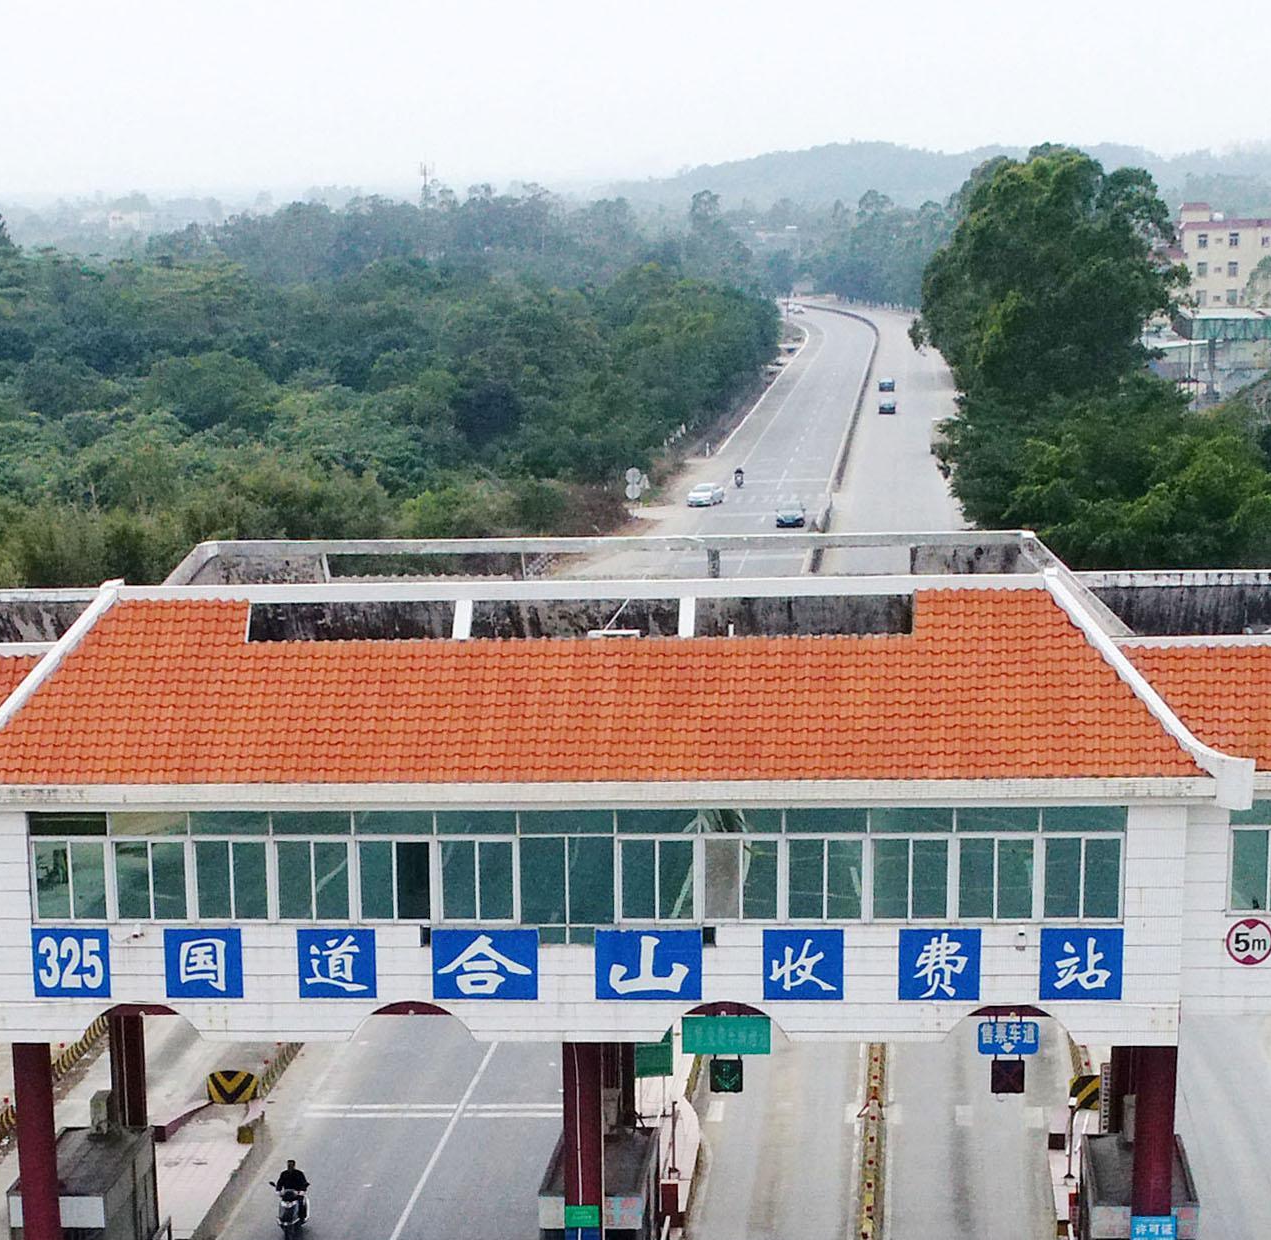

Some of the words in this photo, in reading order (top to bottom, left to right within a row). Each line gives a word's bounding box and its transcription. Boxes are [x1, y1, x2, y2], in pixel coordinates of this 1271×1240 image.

[1234, 932, 1267, 952] 5m
[981, 1022, 1036, 1044] 售票车道
